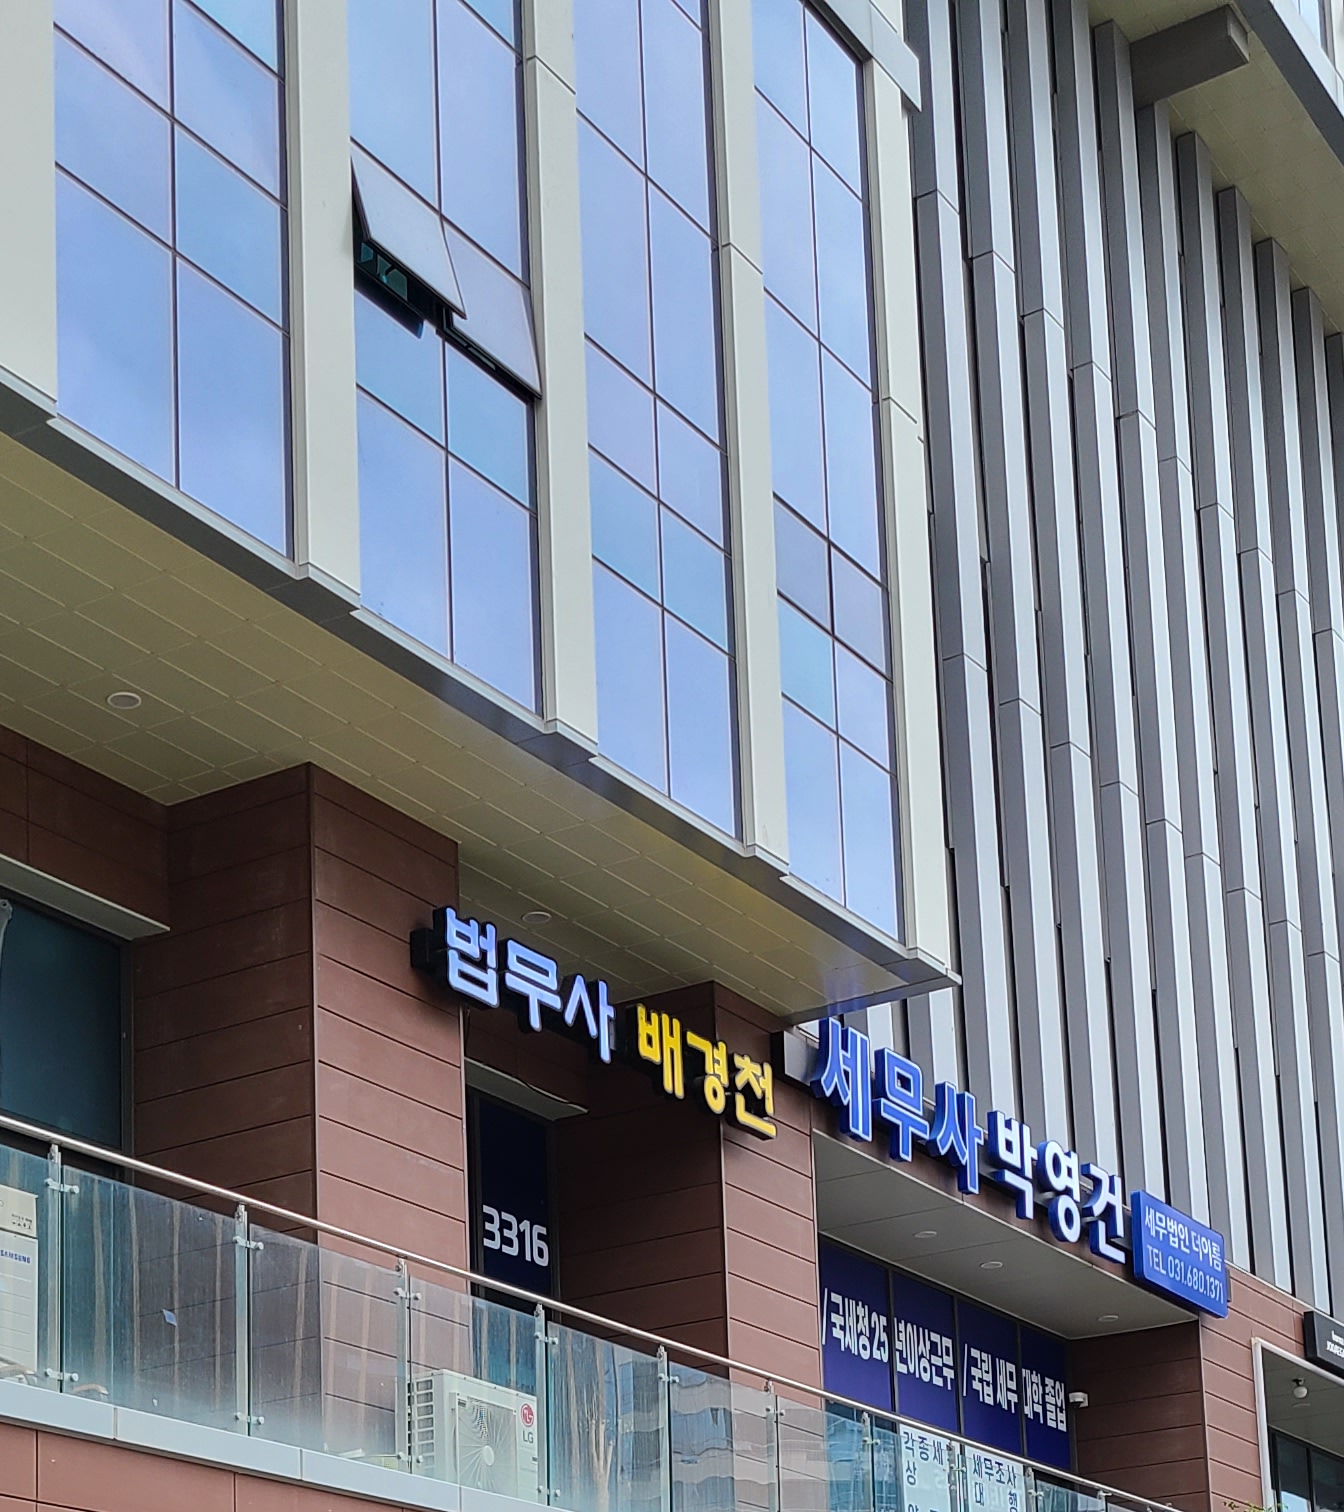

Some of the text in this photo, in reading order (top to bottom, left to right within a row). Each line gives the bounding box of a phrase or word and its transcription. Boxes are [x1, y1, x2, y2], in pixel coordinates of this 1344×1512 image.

[444, 906, 616, 1064] 법무사
[820, 1016, 984, 1194] 세무사
[0, 1249, 31, 1264] SAMSUNG
[482, 1204, 549, 1267] 3316
[1145, 1205, 1190, 1254] 세무법인
[1147, 1244, 1224, 1304] TEL 031.680.1371
[830, 1290, 870, 1361] 국세청
[970, 1347, 993, 1406] 국립
[1044, 1377, 1067, 1433] 졸업
[522, 1430, 534, 1444] LG
[972, 1453, 1017, 1490] 세무조사
